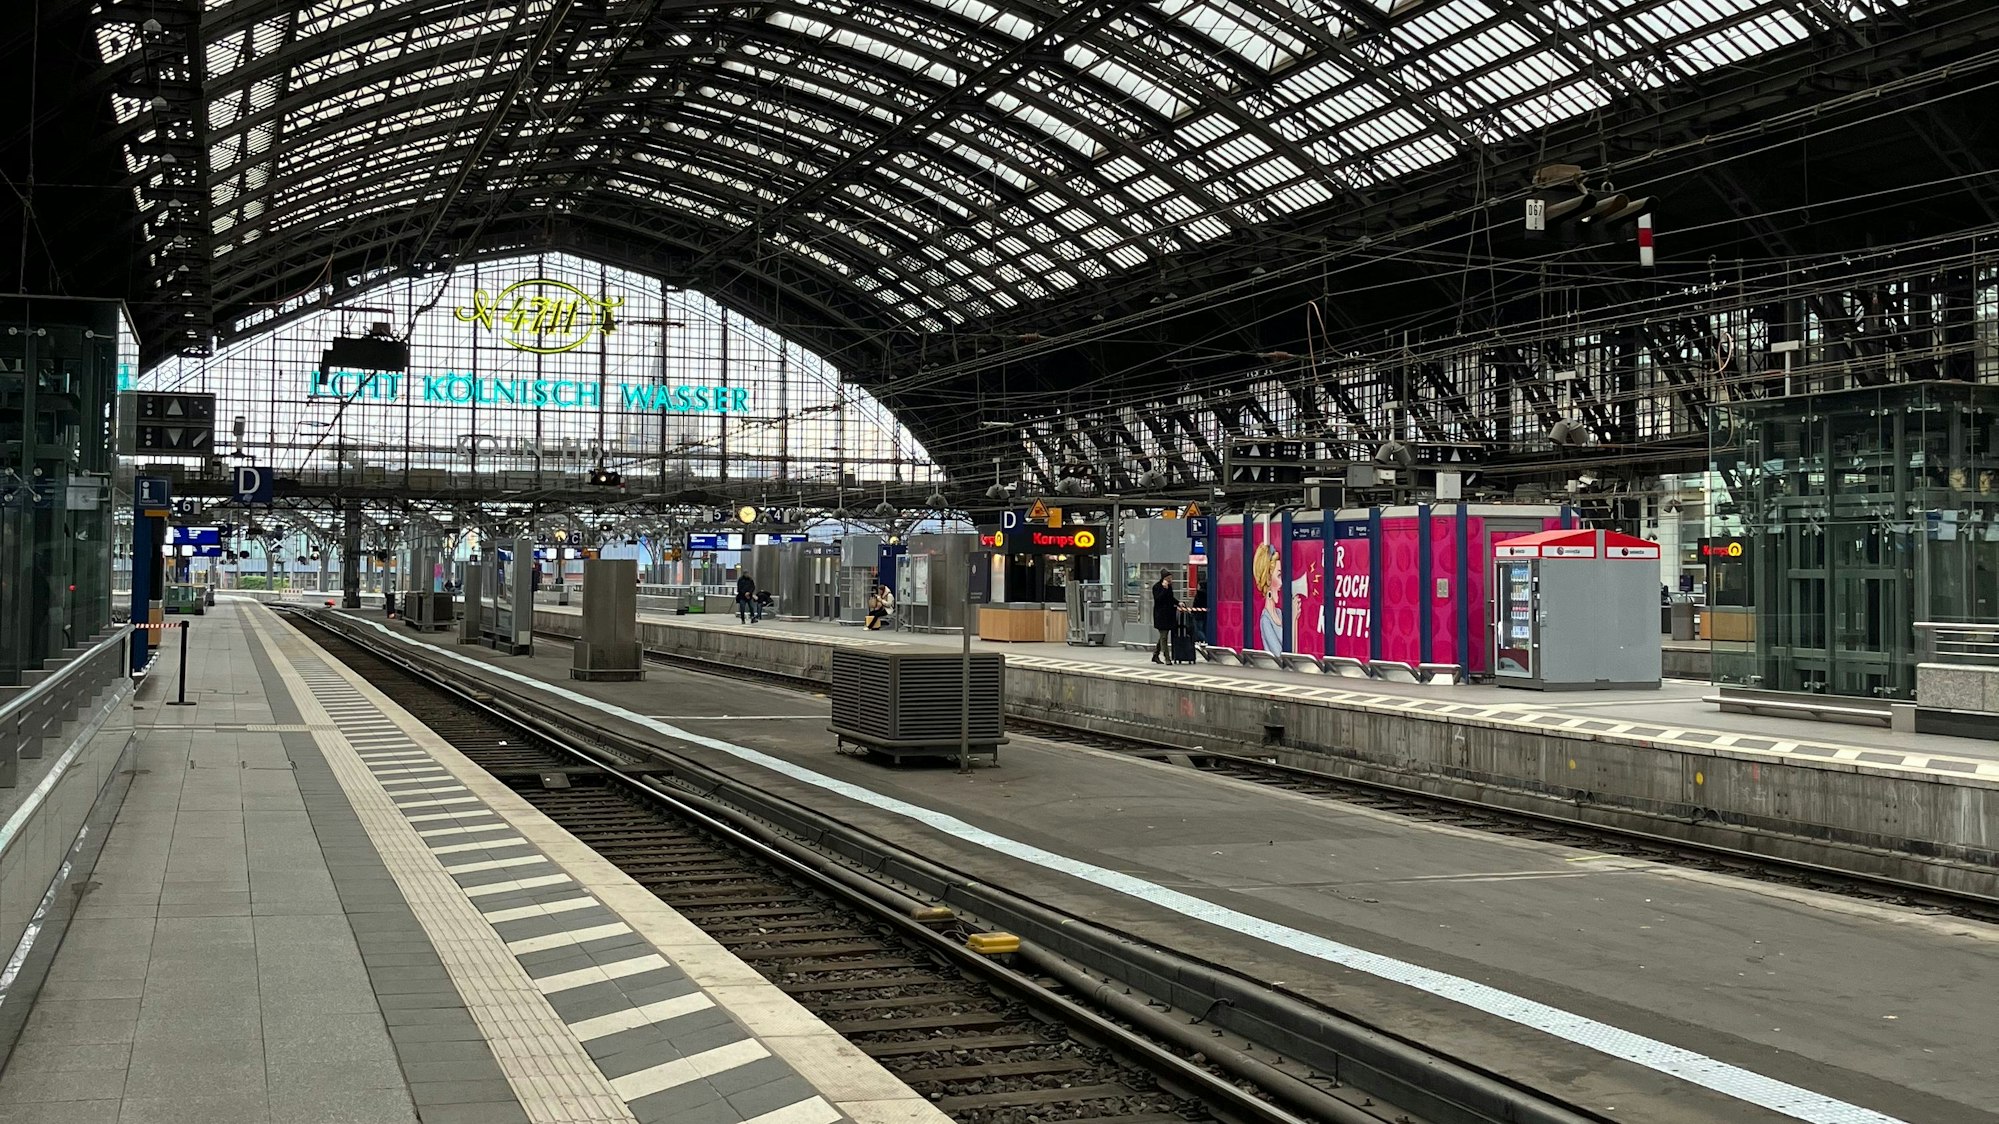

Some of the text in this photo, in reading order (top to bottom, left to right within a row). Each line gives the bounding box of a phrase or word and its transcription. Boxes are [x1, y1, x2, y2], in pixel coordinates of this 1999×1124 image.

[1528, 204, 1543, 217] 067
[503, 296, 580, 336] 4711
[422, 370, 601, 408] KÖLNISCH
[619, 383, 749, 414] WASSER
[238, 467, 261, 495] D
[182, 500, 192, 512] 6
[713, 509, 722, 520] 5
[773, 509, 782, 521] 4
[1003, 511, 1017, 529] D
[1033, 532, 1075, 548] Kamps
[1334, 574, 1370, 598] ZOCH
